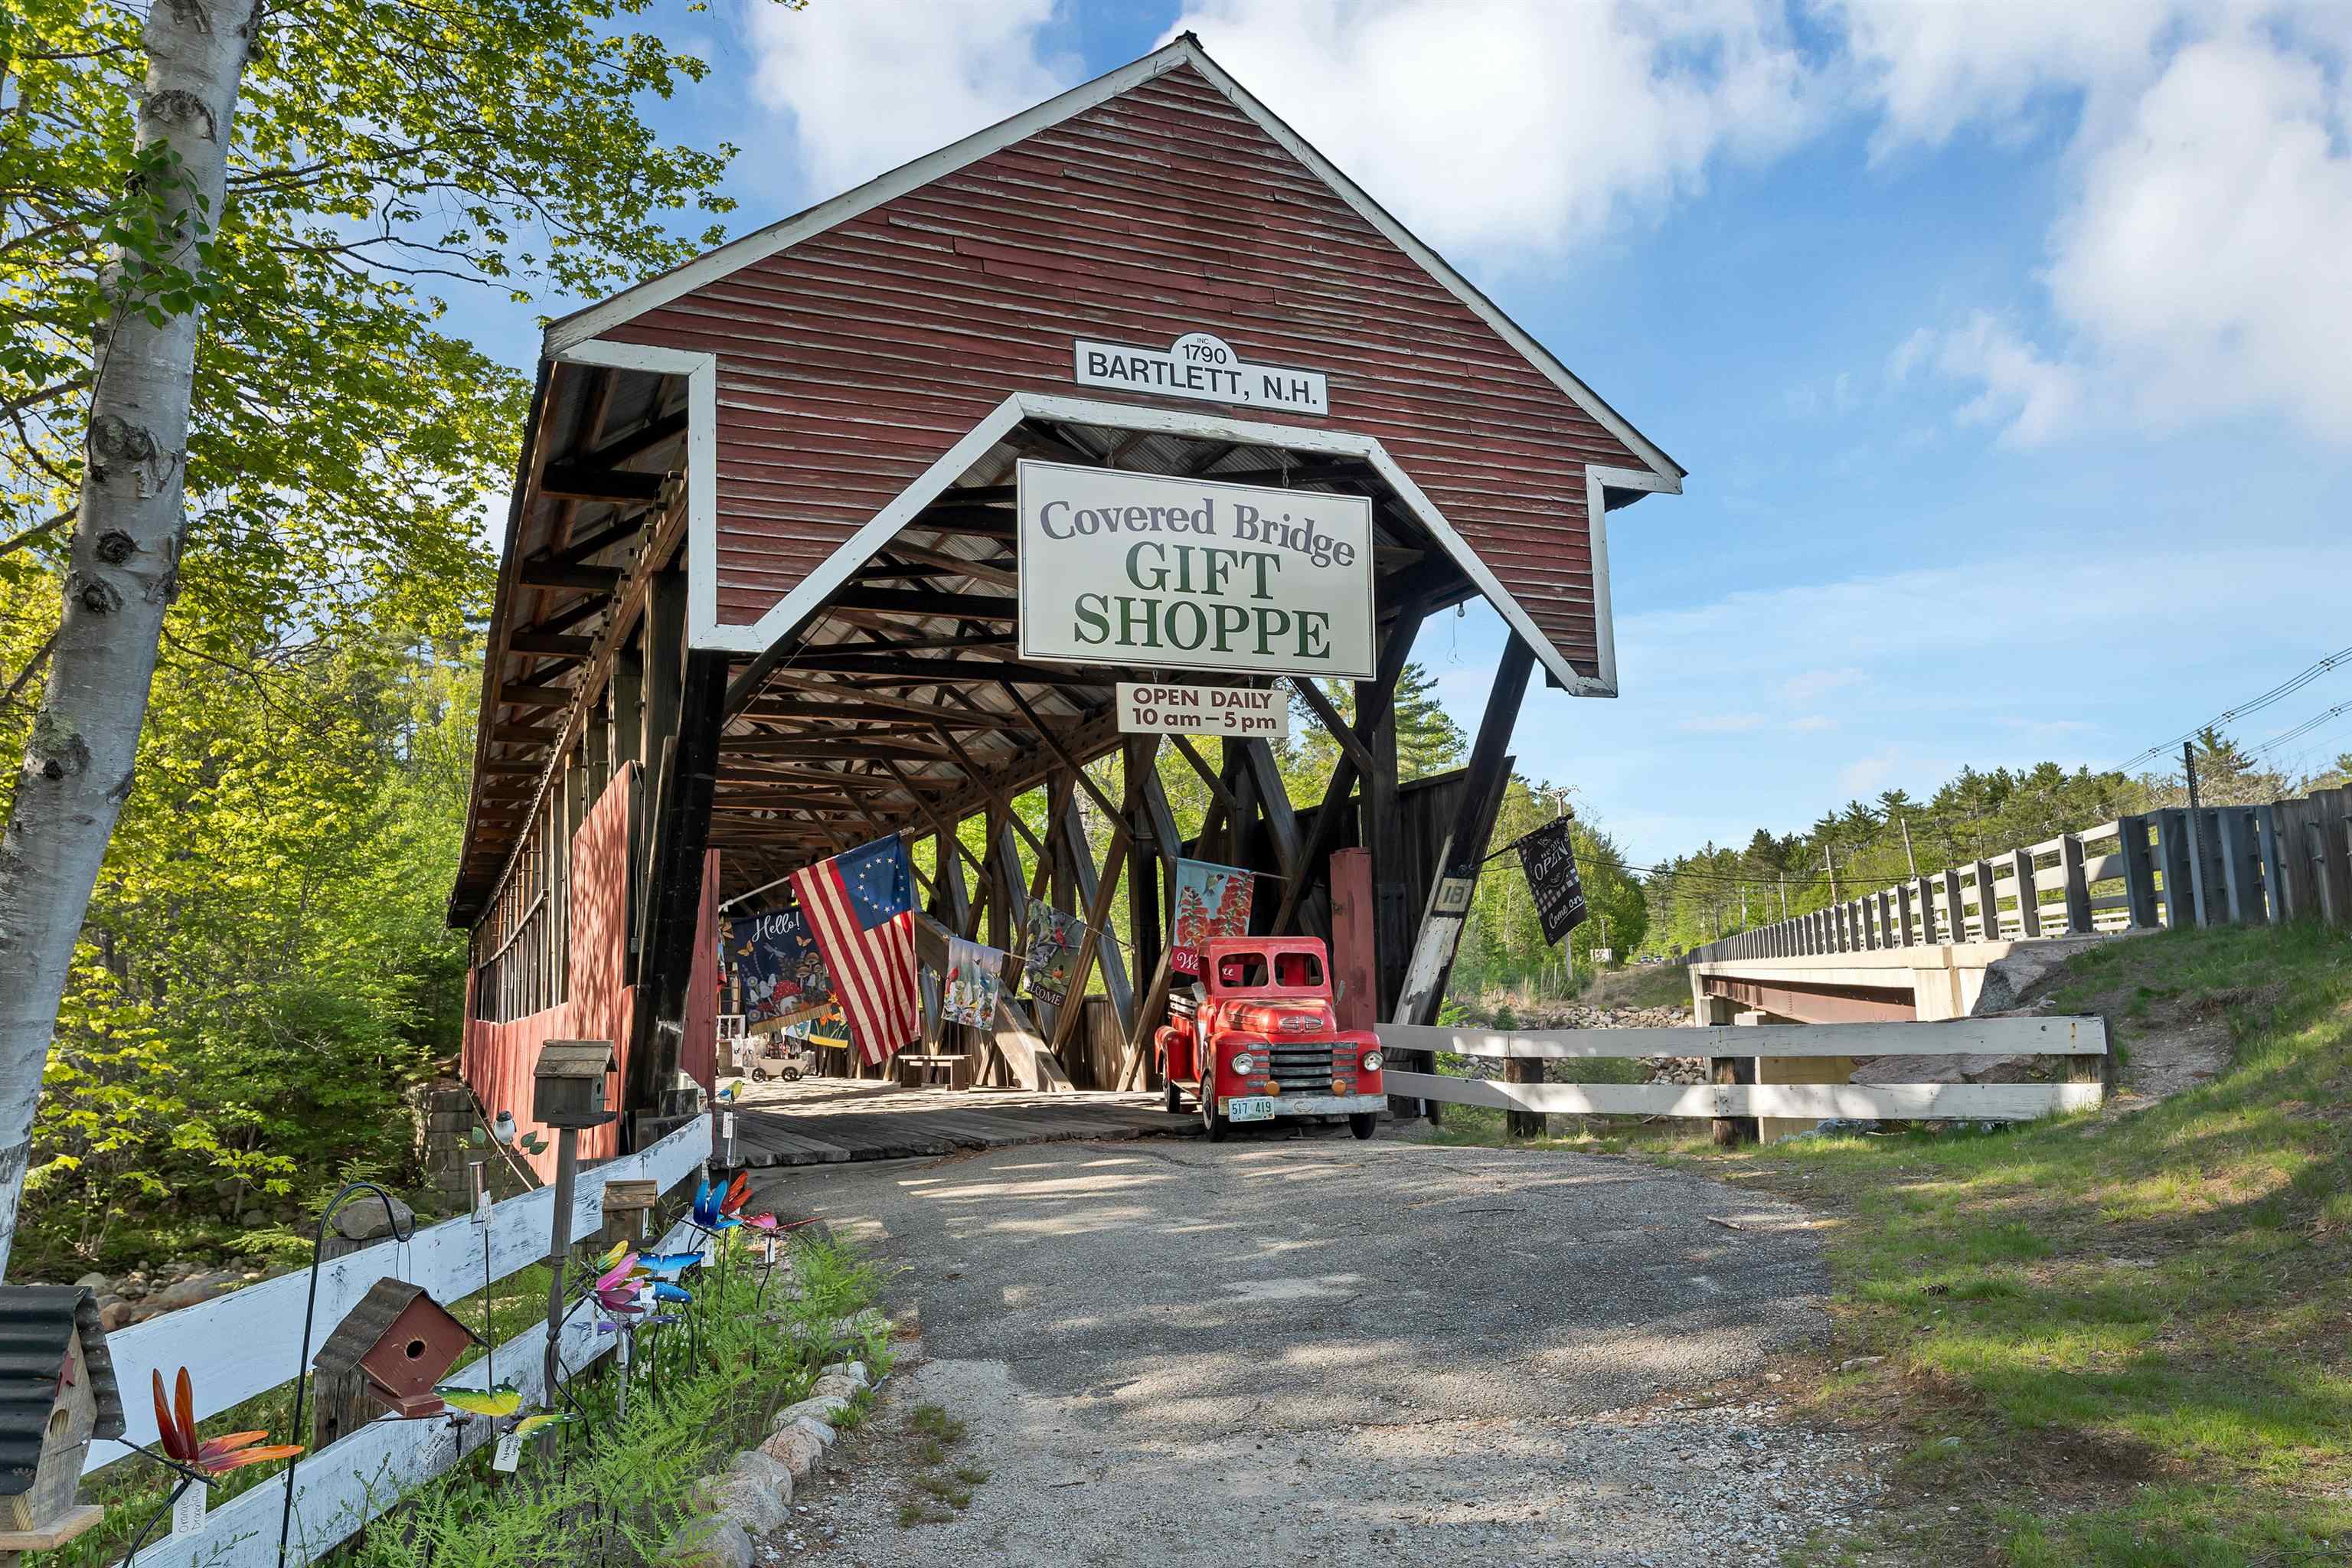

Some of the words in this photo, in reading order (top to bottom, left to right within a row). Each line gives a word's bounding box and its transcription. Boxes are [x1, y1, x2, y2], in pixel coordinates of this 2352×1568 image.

[1182, 344, 1227, 364] 1790
[1088, 351, 1250, 401] BARTLETT,
[1263, 374, 1318, 405] N.H.
[1040, 497, 1217, 541] Covered
[1232, 503, 1355, 568] Bridge
[1125, 540, 1281, 599] GIFT
[1073, 593, 1331, 659] SHOPPE
[1133, 687, 1199, 707] OPEN
[1210, 691, 1274, 709] DAILY
[1132, 707, 1158, 725] 10
[1163, 712, 1201, 727] am
[1224, 711, 1237, 728] 5
[1241, 715, 1277, 733] pm
[1534, 841, 1569, 880] OPEN
[752, 910, 800, 942] Hello!
[1548, 905, 1568, 929] Come
[1232, 1102, 1248, 1115] 517
[1255, 1101, 1271, 1113] 419
[178, 1498, 193, 1533] Orange
